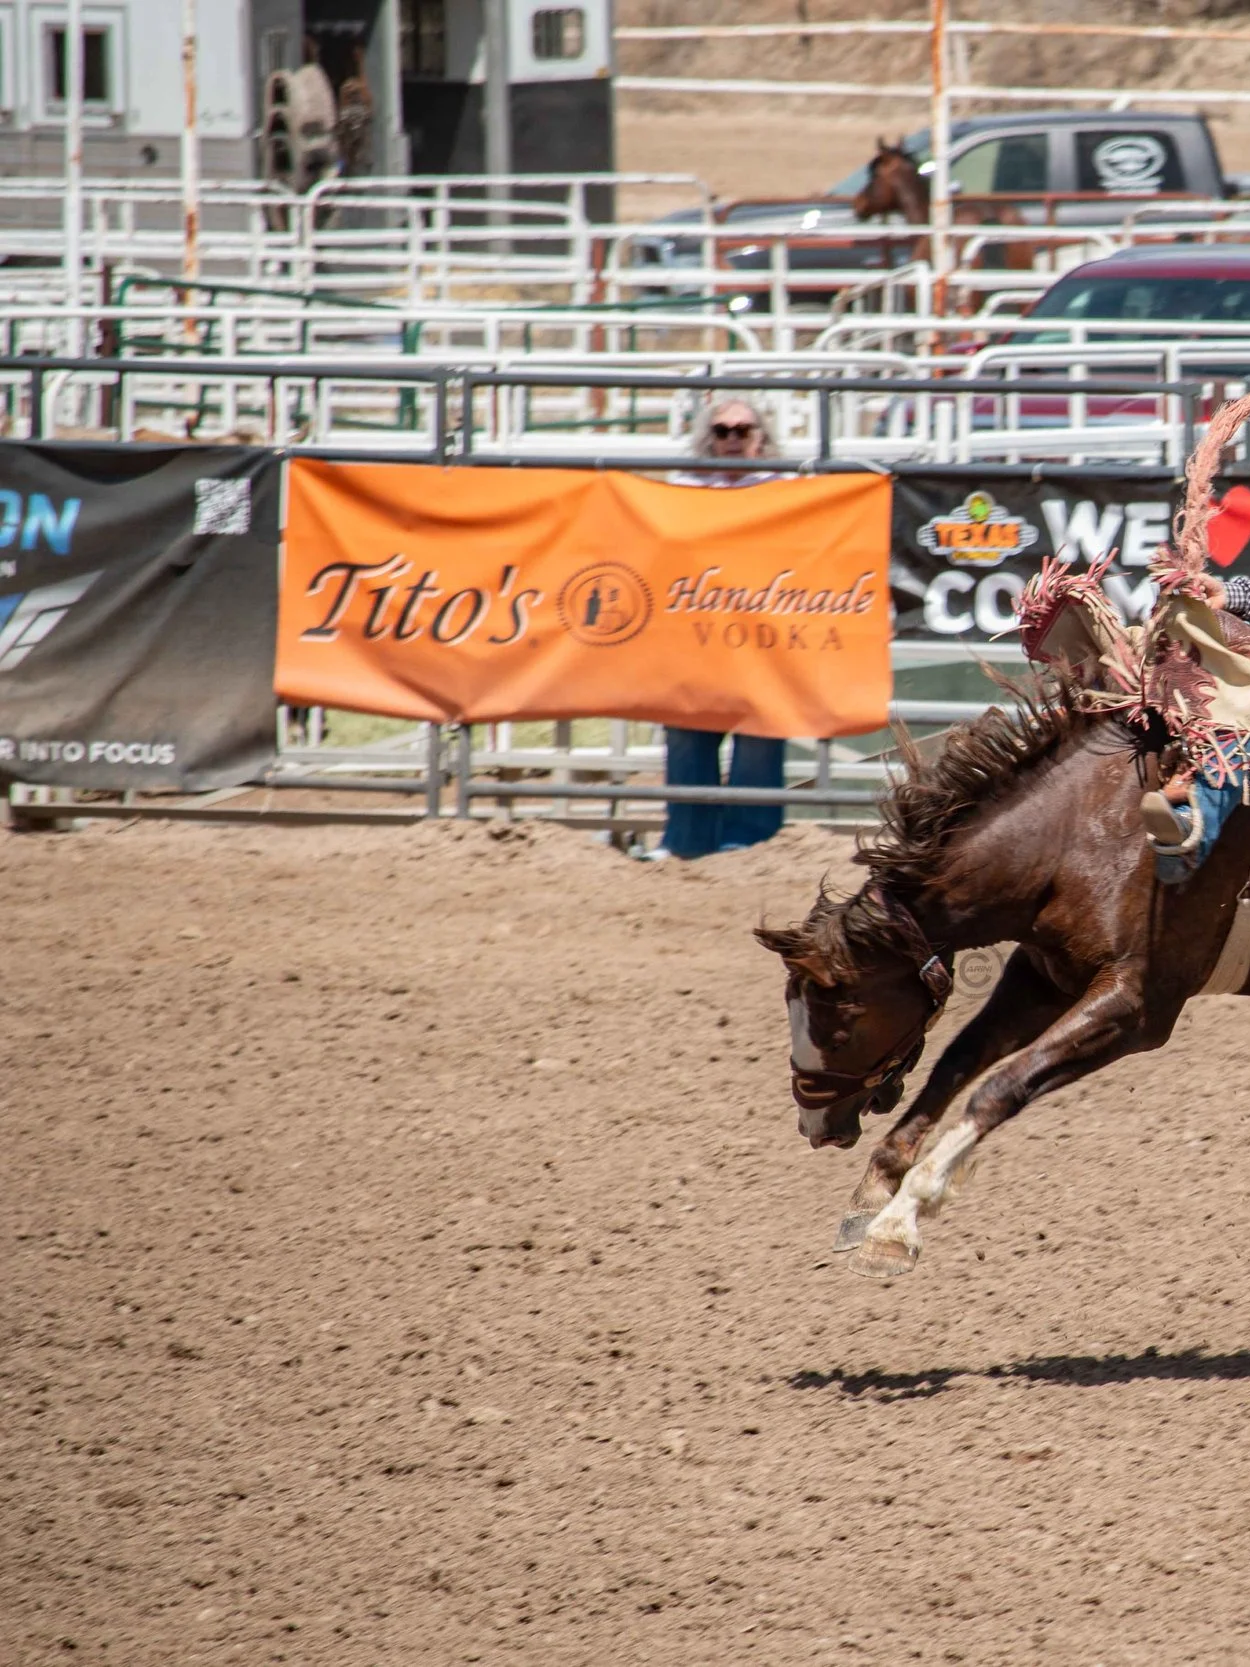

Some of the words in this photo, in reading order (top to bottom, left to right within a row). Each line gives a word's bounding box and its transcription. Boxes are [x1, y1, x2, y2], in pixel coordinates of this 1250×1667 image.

[935, 522, 1019, 548] TEXAS
[1041, 499, 1171, 566] WE
[300, 554, 544, 646] Tito's
[665, 566, 876, 615] Handmade
[692, 620, 844, 652] VODKA
[20, 742, 83, 762] INTO
[88, 742, 176, 765] FOCUS
